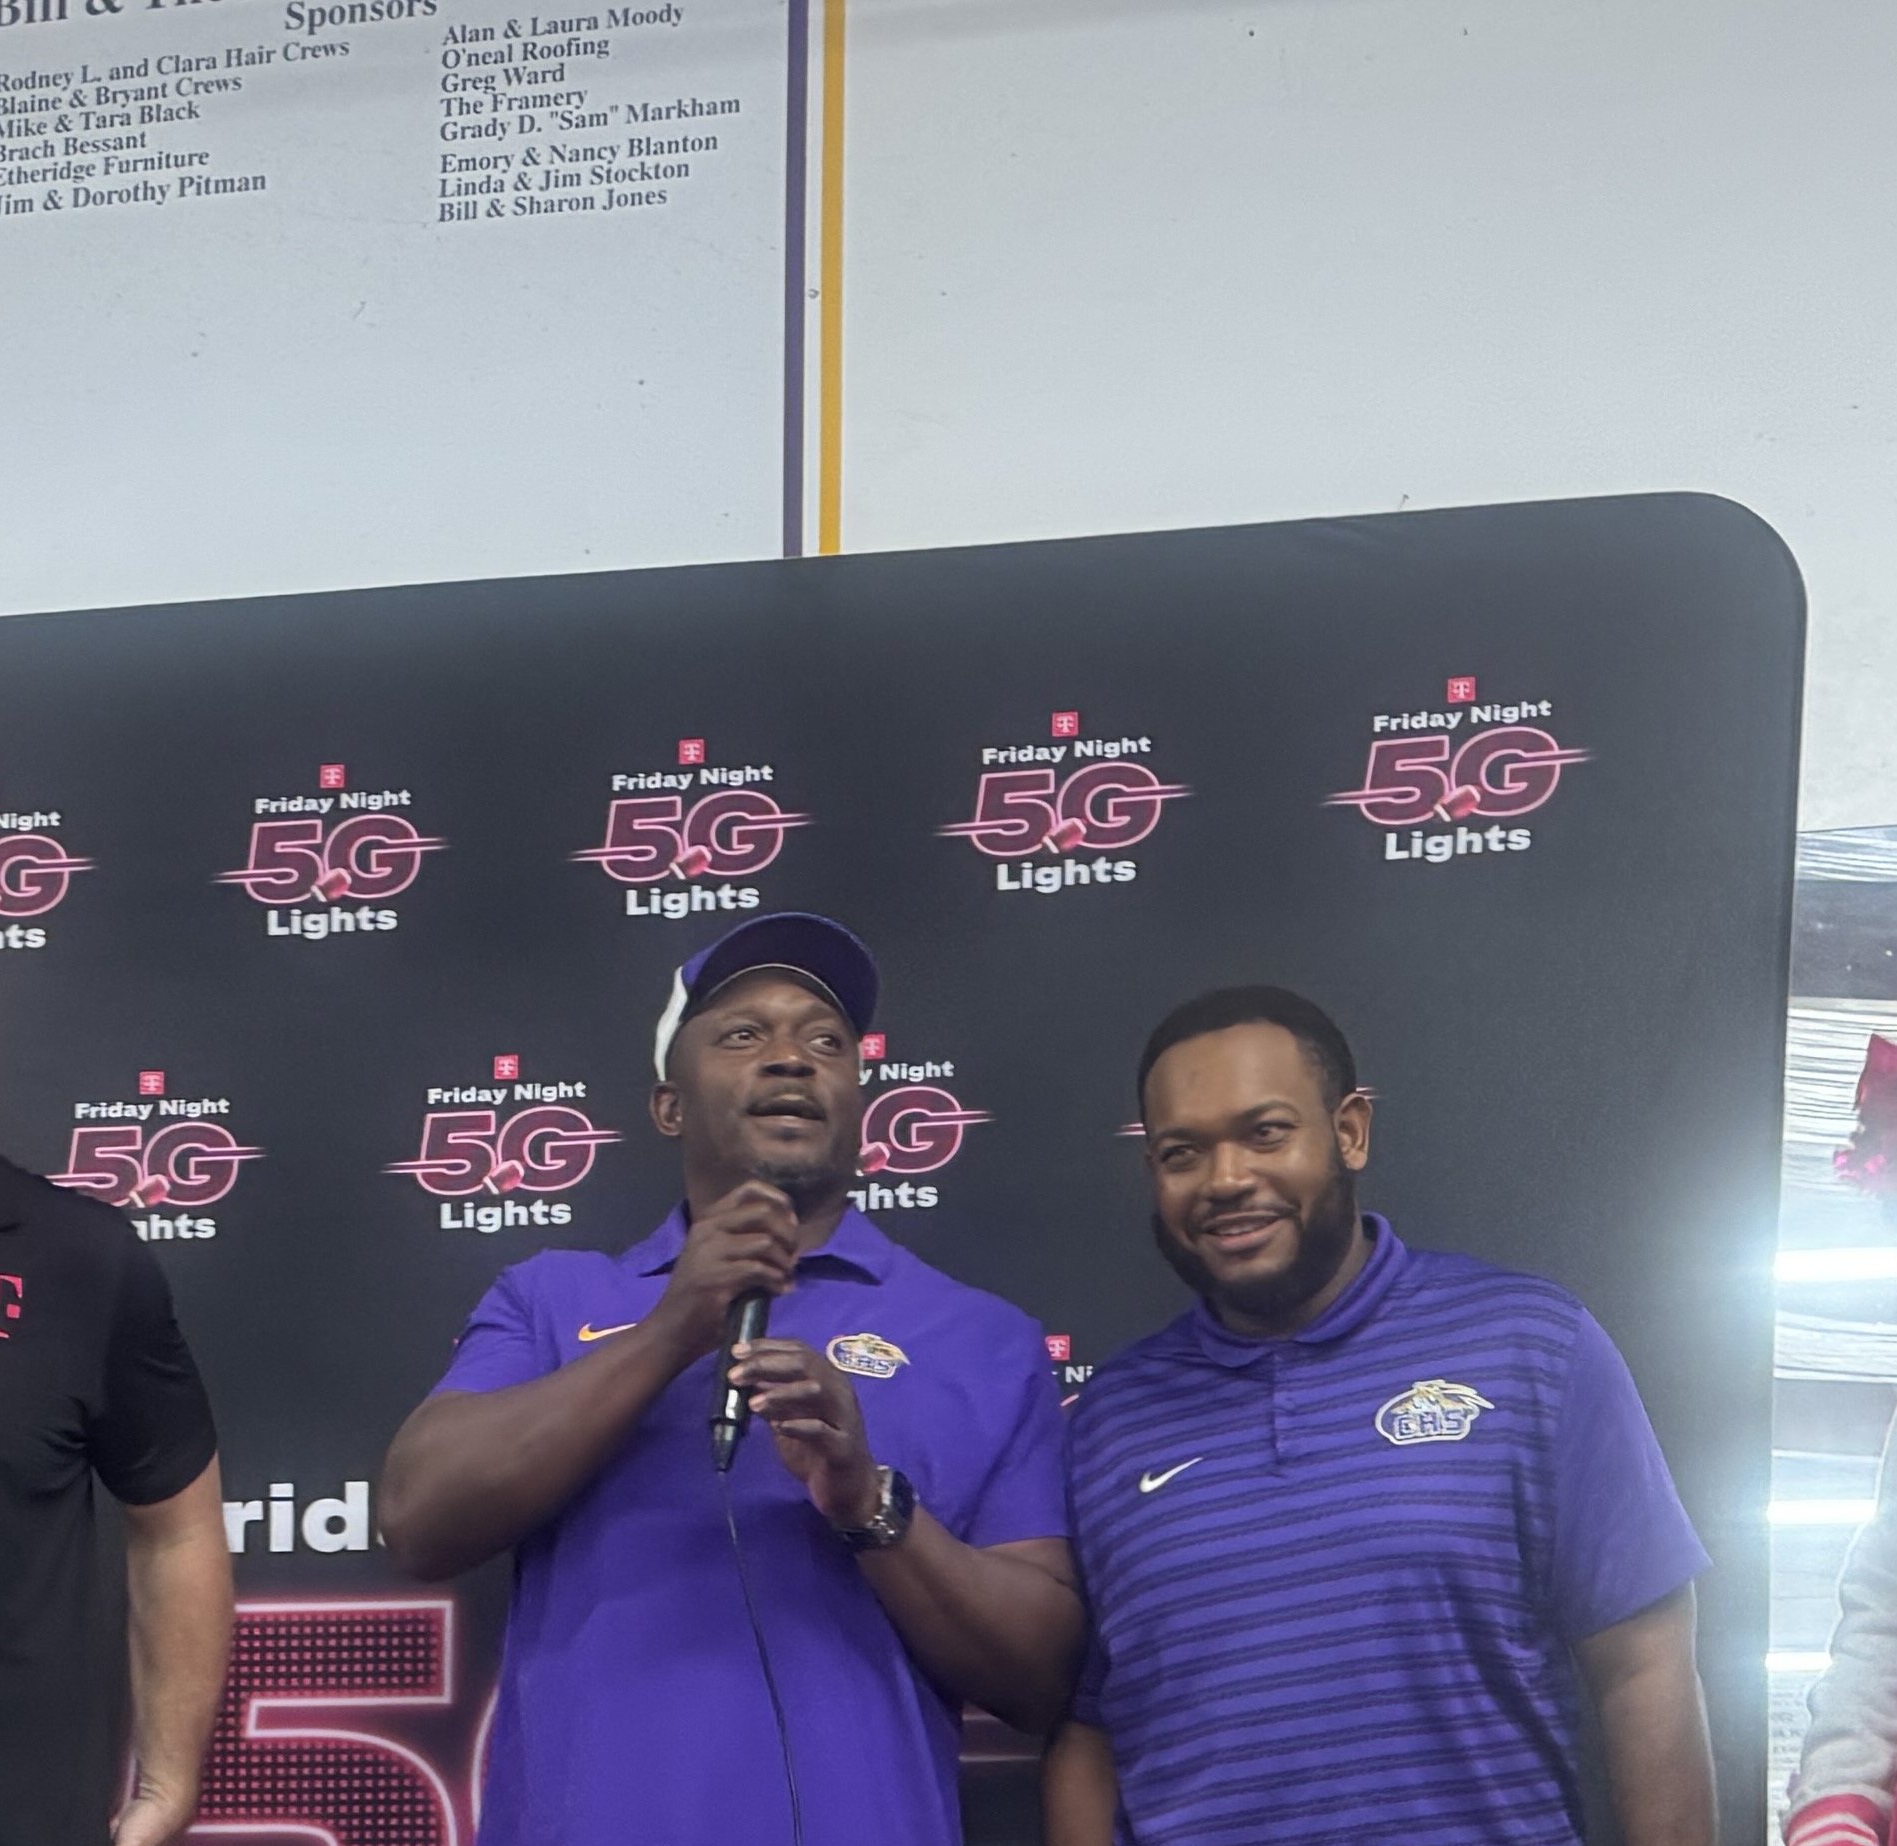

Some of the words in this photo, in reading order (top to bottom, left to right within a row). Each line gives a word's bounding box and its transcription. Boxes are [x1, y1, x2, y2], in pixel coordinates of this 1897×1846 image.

[285, 0, 437, 36] Sponsors
[442, 25, 495, 46] Alan
[503, 19, 523, 38] &
[531, 14, 598, 36] Laura
[607, 3, 685, 28] Moody
[81, 64, 102, 84] L.
[109, 59, 149, 81] and
[156, 53, 217, 76] Clara
[225, 45, 276, 68] Hair
[283, 39, 350, 62] Crews
[441, 44, 513, 69] O'neal
[522, 37, 610, 61] Roofing
[70, 91, 88, 108] &
[95, 82, 168, 108] Bryant
[175, 76, 243, 96] Crews
[441, 71, 496, 95] Greg
[502, 64, 565, 87] Ward
[54, 115, 73, 133] &
[79, 109, 131, 131] Tara
[139, 103, 200, 125] Black
[440, 95, 484, 118] The
[492, 89, 588, 113] Framery
[440, 118, 510, 142] Grady
[518, 114, 542, 135] D.
[551, 105, 619, 131] "Sam"
[625, 96, 741, 124] Markham
[63, 131, 147, 155] Bessant
[440, 152, 514, 174] Emory
[522, 148, 541, 167] &
[549, 142, 620, 165] Nancy
[627, 134, 718, 158] Blanton
[104, 150, 210, 176] Furniture
[439, 175, 506, 198] Linda
[513, 172, 532, 192] &
[538, 169, 581, 191] Jim
[590, 160, 689, 185] Stockton
[42, 190, 64, 211] &
[72, 180, 170, 208] Dorothy
[178, 173, 266, 198] Pitman
[438, 201, 478, 223] Bill
[486, 199, 505, 218] &
[512, 194, 595, 216] Sharon
[602, 187, 668, 211] Jones
[1373, 710, 1463, 733] Friday
[1471, 699, 1551, 723] Night
[982, 743, 1067, 764] Friday
[1074, 736, 1151, 758] Night
[612, 771, 693, 791] Friday
[699, 765, 773, 784] Night
[1353, 726, 1569, 824] 5G
[255, 795, 334, 814] Friday
[340, 790, 411, 810] Night
[965, 762, 1169, 856] 5G
[595, 791, 791, 881] 5G
[1385, 825, 1531, 863] Lights
[239, 815, 428, 903] 5G
[996, 856, 1137, 893] Lights
[626, 884, 760, 918] Lights
[267, 907, 397, 939] Lights
[879, 1061, 954, 1082] Night
[75, 1101, 153, 1120] Friday
[159, 1098, 230, 1118] Night
[427, 1086, 507, 1105] Friday
[513, 1081, 586, 1100] Night
[862, 1086, 971, 1174] G
[59, 1121, 246, 1206] 5G
[410, 1106, 603, 1195] 5G
[441, 1200, 571, 1232] Lights
